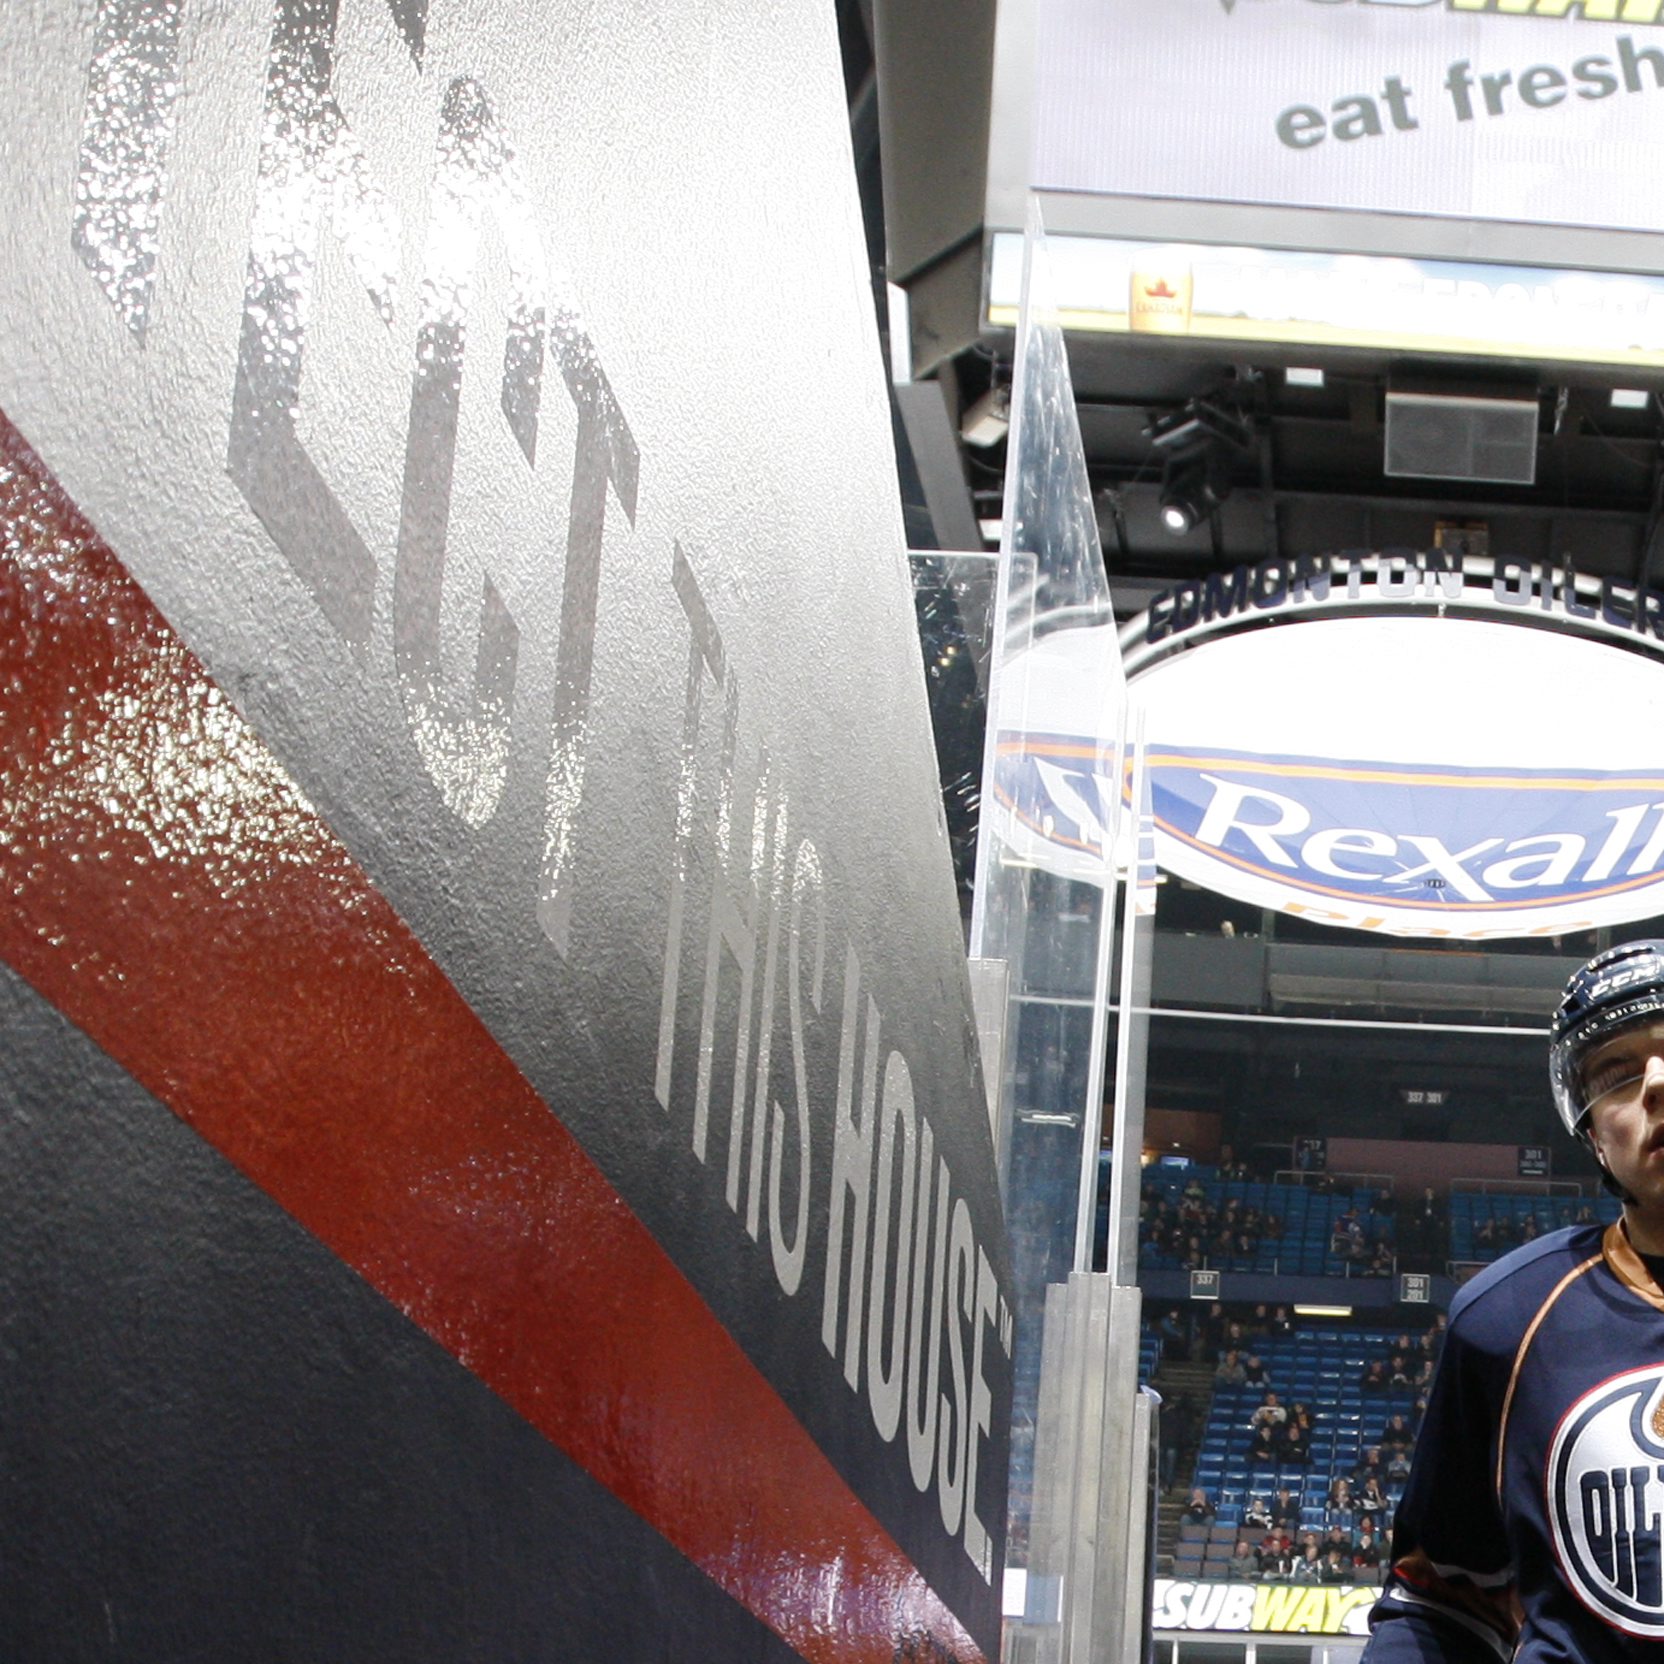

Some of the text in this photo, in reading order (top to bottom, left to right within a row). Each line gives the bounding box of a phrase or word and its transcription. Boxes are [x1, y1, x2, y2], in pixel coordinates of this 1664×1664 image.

[1275, 74, 1420, 150] eat
[1143, 546, 1466, 645] EDMONTON
[1591, 966, 1660, 998] CCM
[822, 935, 999, 1587] HOUSE
[1154, 1583, 1376, 1634] SUBWAY
